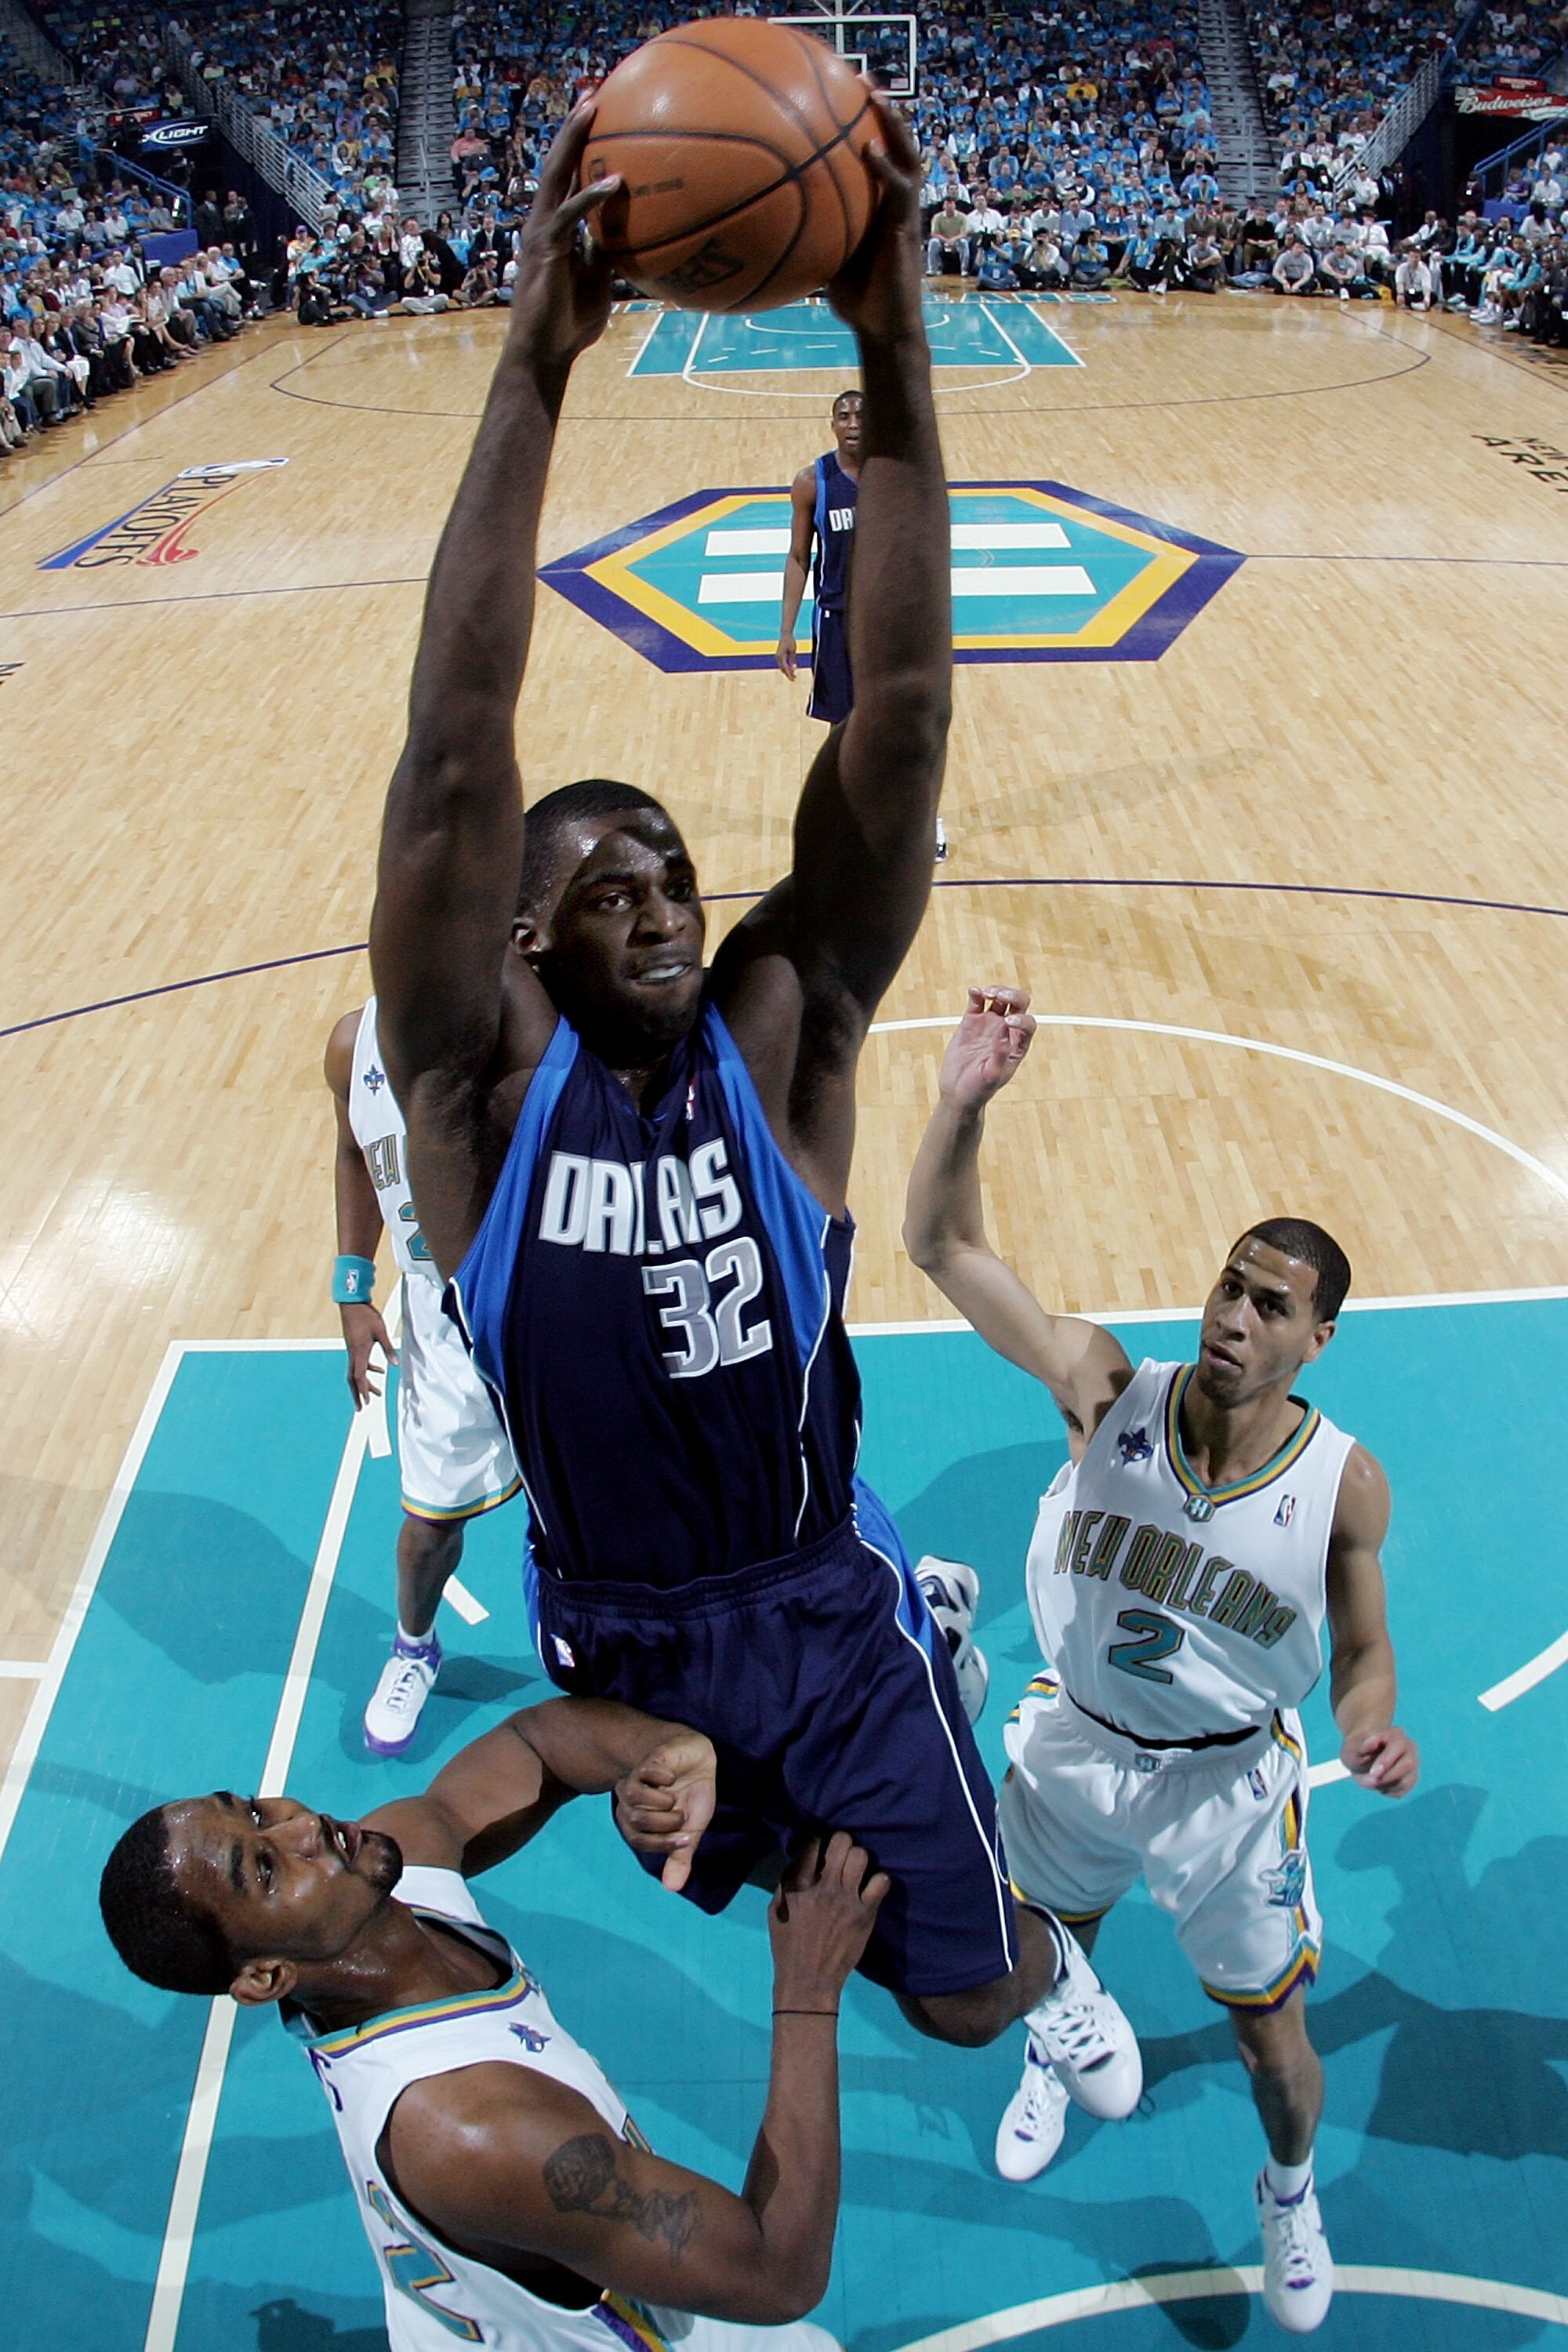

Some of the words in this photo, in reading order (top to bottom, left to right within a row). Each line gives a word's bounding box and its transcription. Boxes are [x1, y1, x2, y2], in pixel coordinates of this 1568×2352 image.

[159, 125, 208, 140] LIGHT
[1458, 94, 1552, 114] Budweiser
[1470, 434, 1568, 492] ARE
[74, 474, 238, 568] PLAYOFFS
[641, 1236, 773, 1378] 32
[1053, 1511, 1132, 1581] NEW
[1118, 1523, 1298, 1650] ORLEANS
[1108, 1610, 1185, 1685] 2
